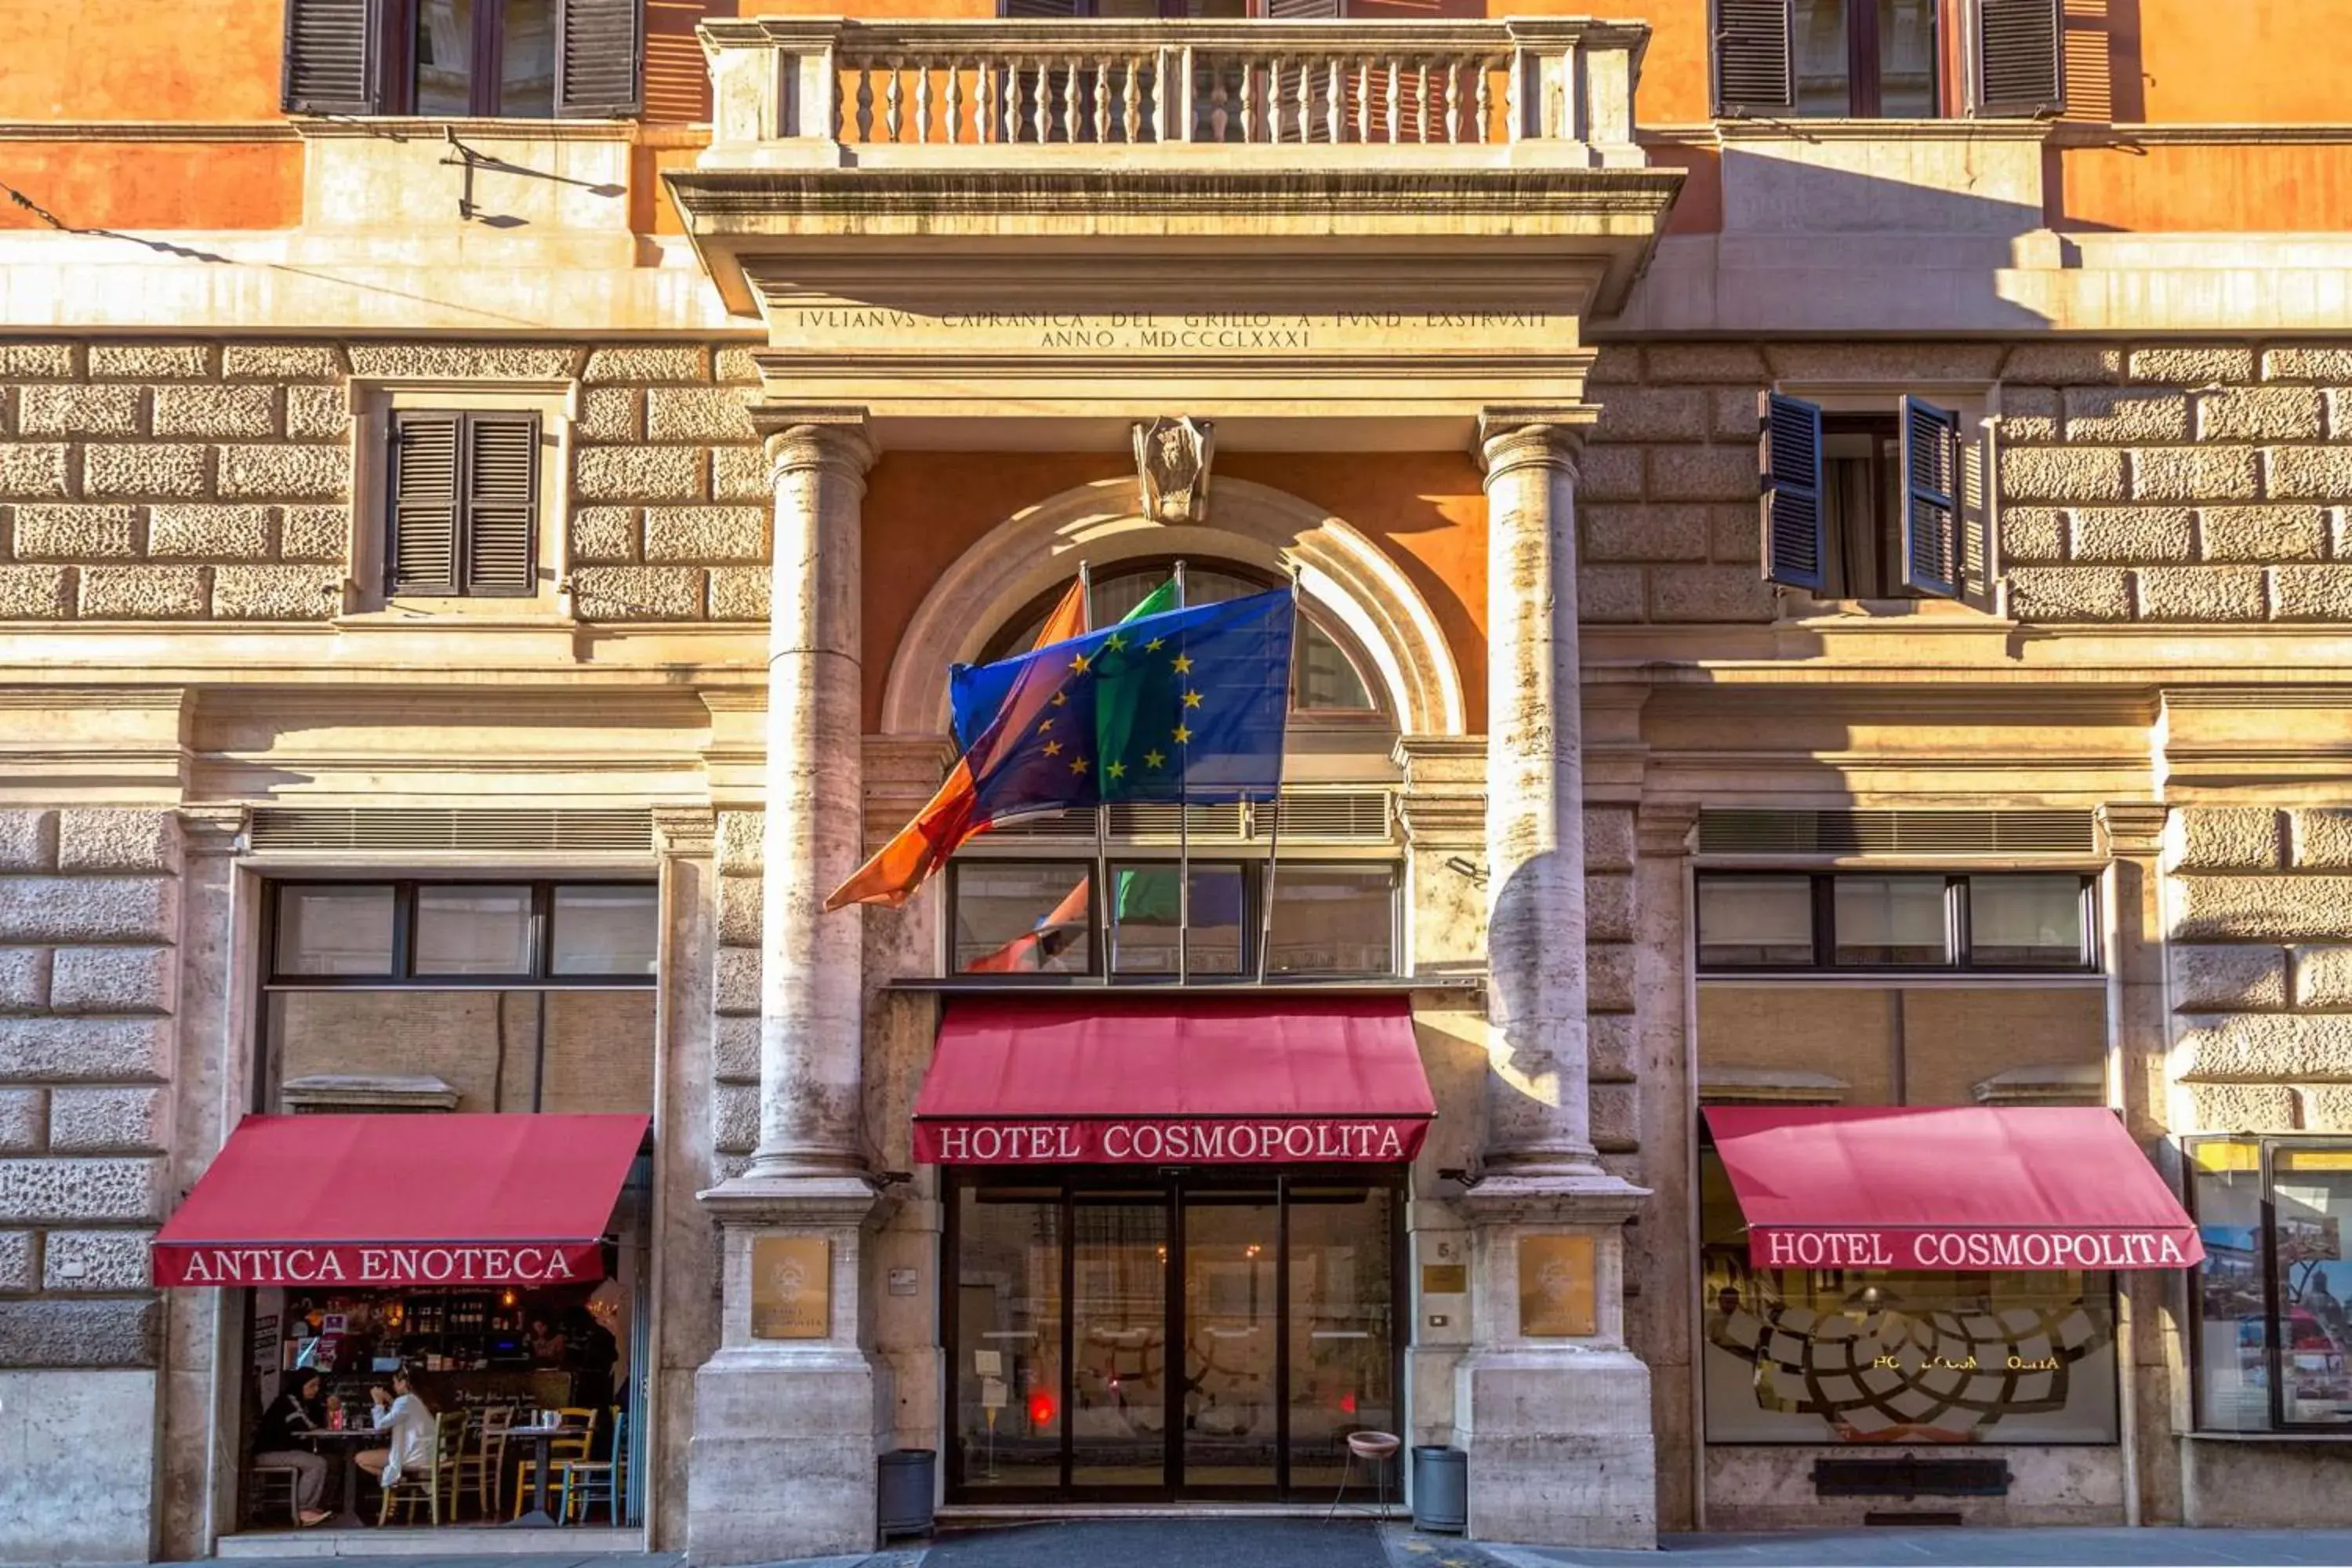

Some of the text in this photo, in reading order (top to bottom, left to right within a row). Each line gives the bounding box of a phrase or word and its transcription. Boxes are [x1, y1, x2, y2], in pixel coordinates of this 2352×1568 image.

[1111, 311, 1159, 328] DEL
[1184, 310, 1272, 328] GRILLO
[1040, 330, 1115, 347] ANNO
[939, 1124, 1405, 1159] HOTEL COSMOPOLITA
[182, 1248, 575, 1281] ANTICA ENOTECA
[1767, 1232, 2186, 1265] HOTEL COSMOPOLITA
